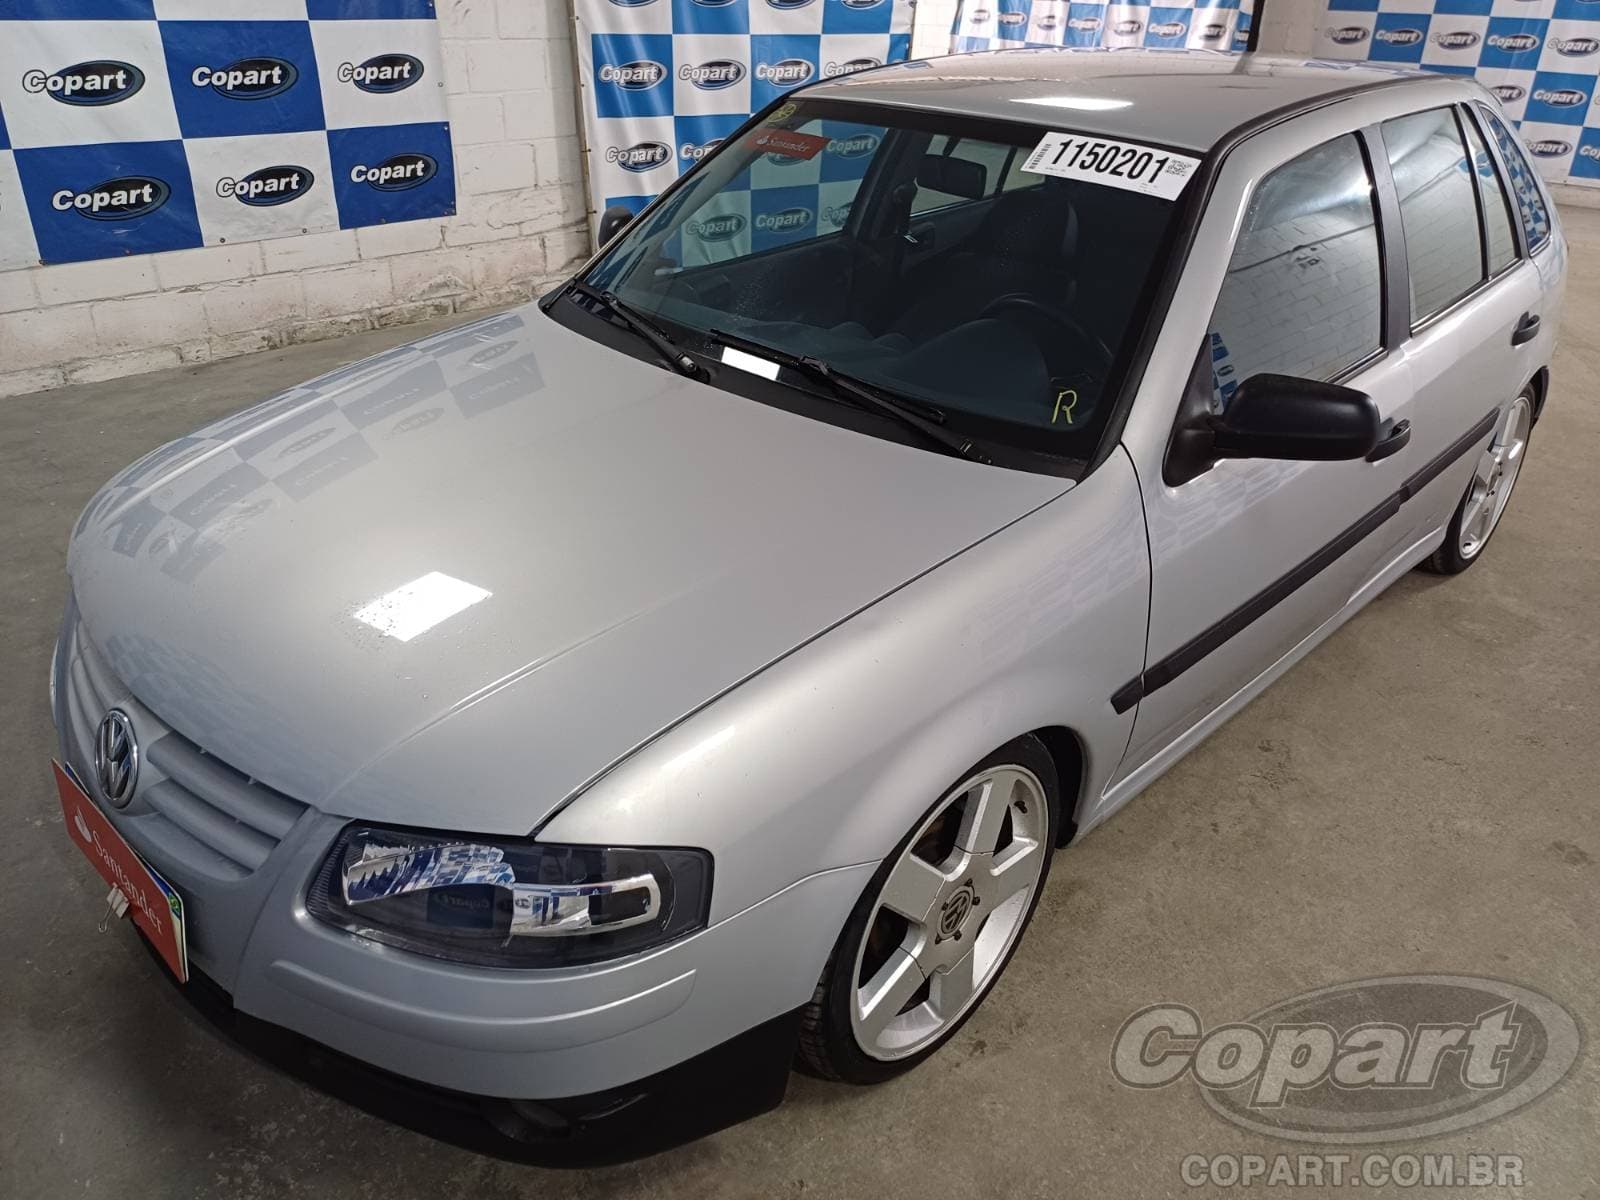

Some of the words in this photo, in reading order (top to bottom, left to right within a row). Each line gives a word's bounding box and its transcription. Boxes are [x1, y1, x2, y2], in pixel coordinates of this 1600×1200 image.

[1375, 30, 1418, 42] Copart
[1431, 32, 1474, 45] Copart
[1487, 35, 1535, 48] Copart
[1547, 38, 1595, 51] Copart
[22, 68, 128, 96] Copart
[191, 66, 283, 90] Copart
[337, 62, 413, 83] Copart
[599, 64, 659, 86] Copart
[679, 64, 737, 84] Copart
[755, 62, 806, 83] Copart
[1533, 90, 1578, 103] Copart
[605, 145, 664, 165] Copart
[826, 138, 873, 155] Copart
[350, 157, 426, 183] Copart
[1052, 139, 1170, 183] 1150201
[216, 171, 301, 197] Copart
[52, 183, 154, 212] Copart
[686, 216, 738, 236] Copart
[755, 209, 807, 229] Copart
[1051, 390, 1077, 424] R
[92, 830, 164, 936] Santander
